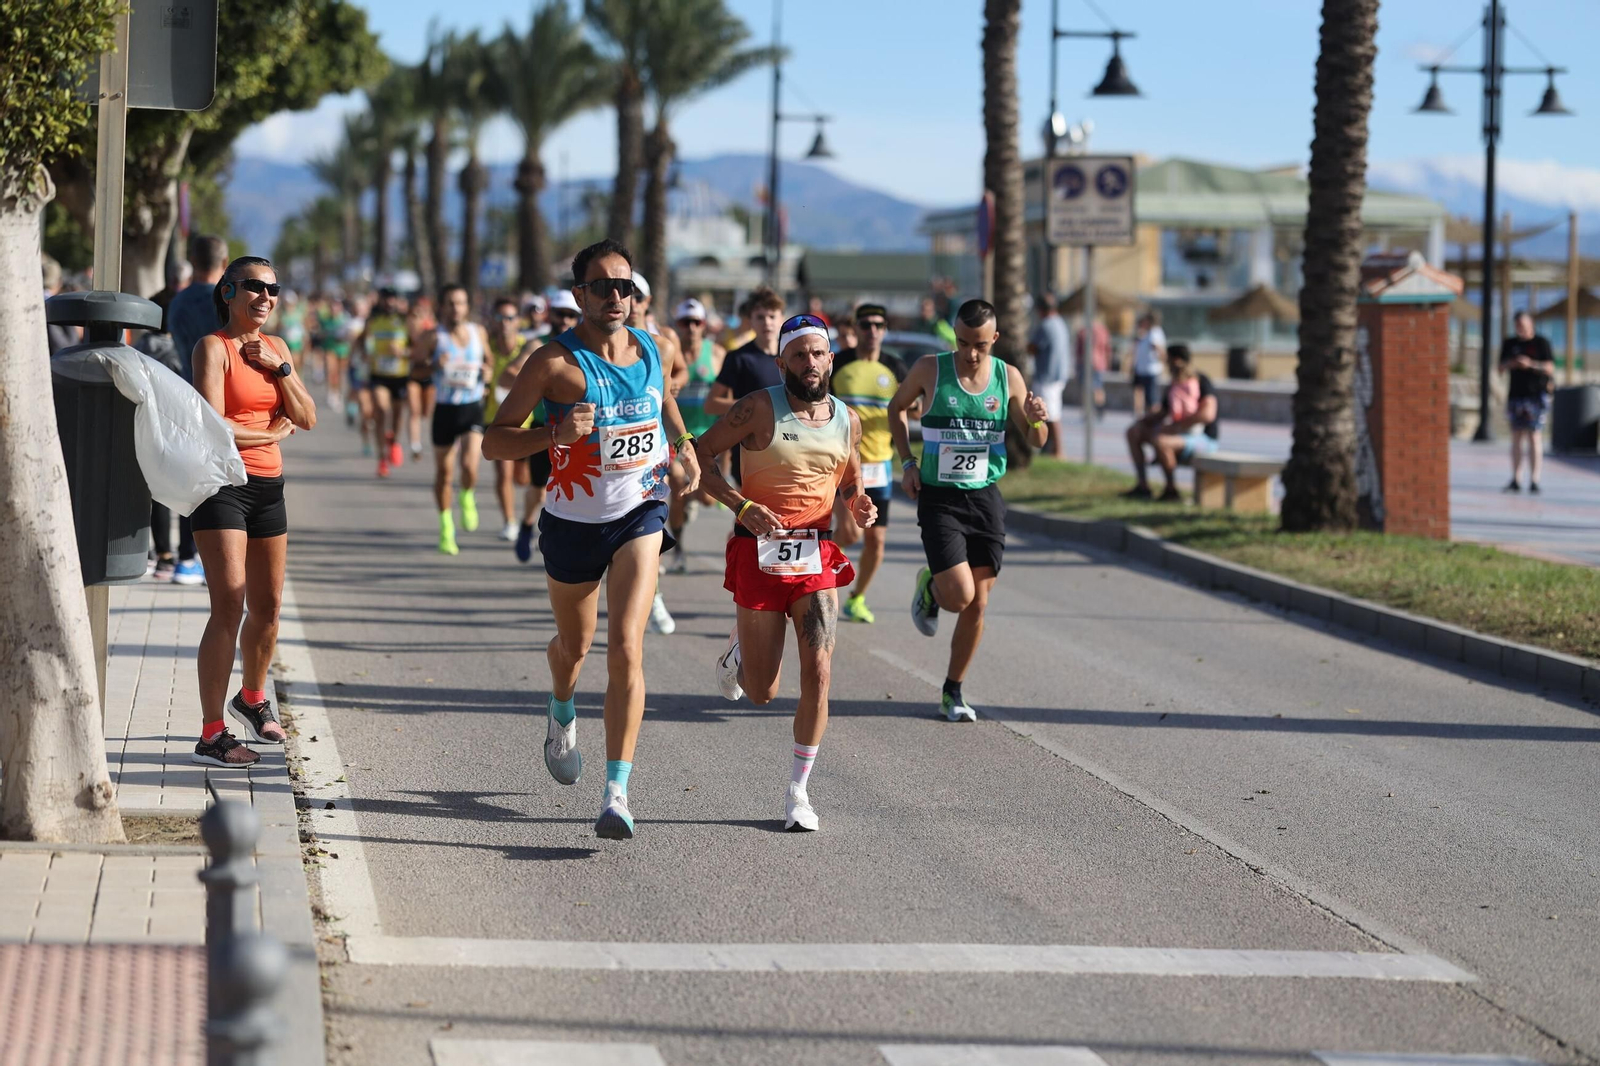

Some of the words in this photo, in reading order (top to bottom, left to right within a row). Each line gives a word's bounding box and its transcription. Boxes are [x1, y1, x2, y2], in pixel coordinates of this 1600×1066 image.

[597, 401, 651, 418] cudeca
[949, 418, 995, 430] ATLETISMO
[610, 432, 654, 459] 283
[952, 454, 977, 470] 28
[777, 541, 802, 561] 51
